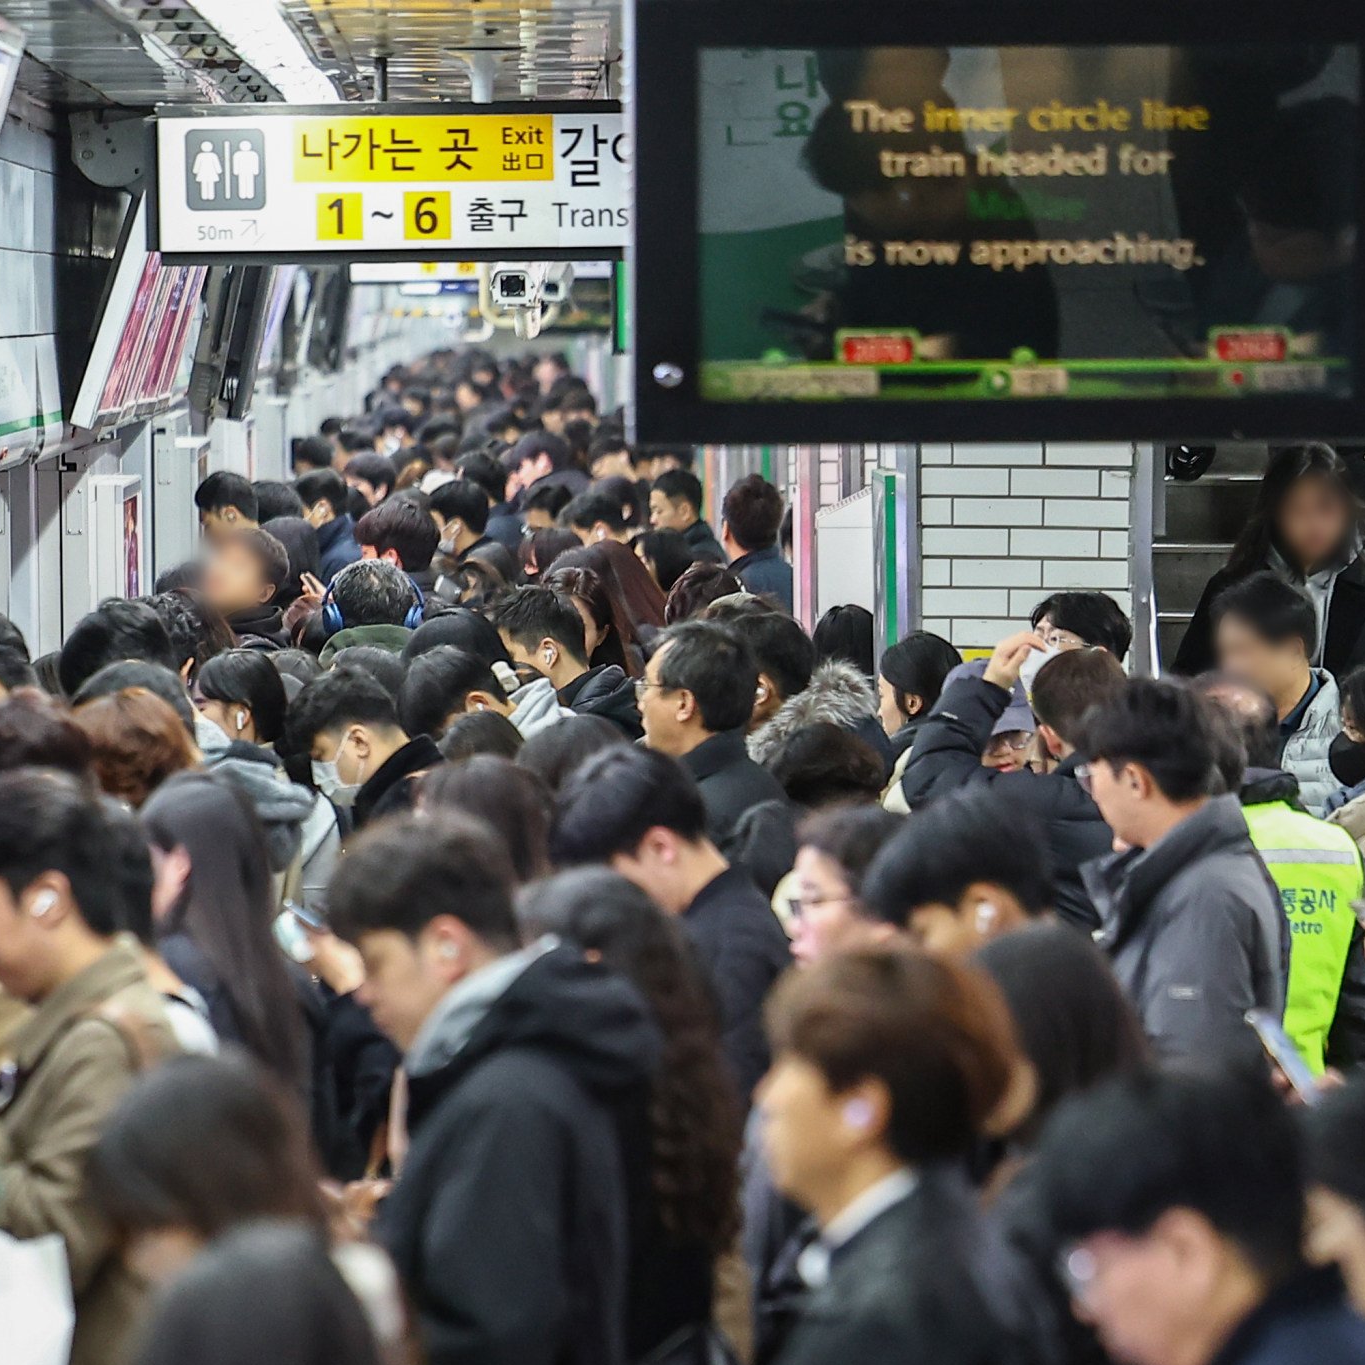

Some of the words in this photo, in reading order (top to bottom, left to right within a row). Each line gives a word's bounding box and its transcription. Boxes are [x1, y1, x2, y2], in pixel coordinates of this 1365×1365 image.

[845, 101, 914, 134] The
[924, 100, 1016, 133] inner
[1028, 99, 1130, 133] circle
[1141, 99, 1210, 132] line
[302, 128, 422, 171] 나가는
[439, 128, 479, 171] 곳
[501, 126, 544, 146] Exit
[502, 152, 544, 171] 出口
[879, 146, 965, 178] train
[977, 144, 1107, 178] headed
[1120, 144, 1175, 177] for
[197, 225, 234, 240] 50m
[327, 198, 345, 235] 1
[414, 197, 439, 235] 6
[466, 197, 529, 232] 출구
[844, 234, 877, 266] is
[885, 240, 959, 266] now
[970, 232, 1206, 271] approaching.
[1288, 919, 1323, 935] etro
